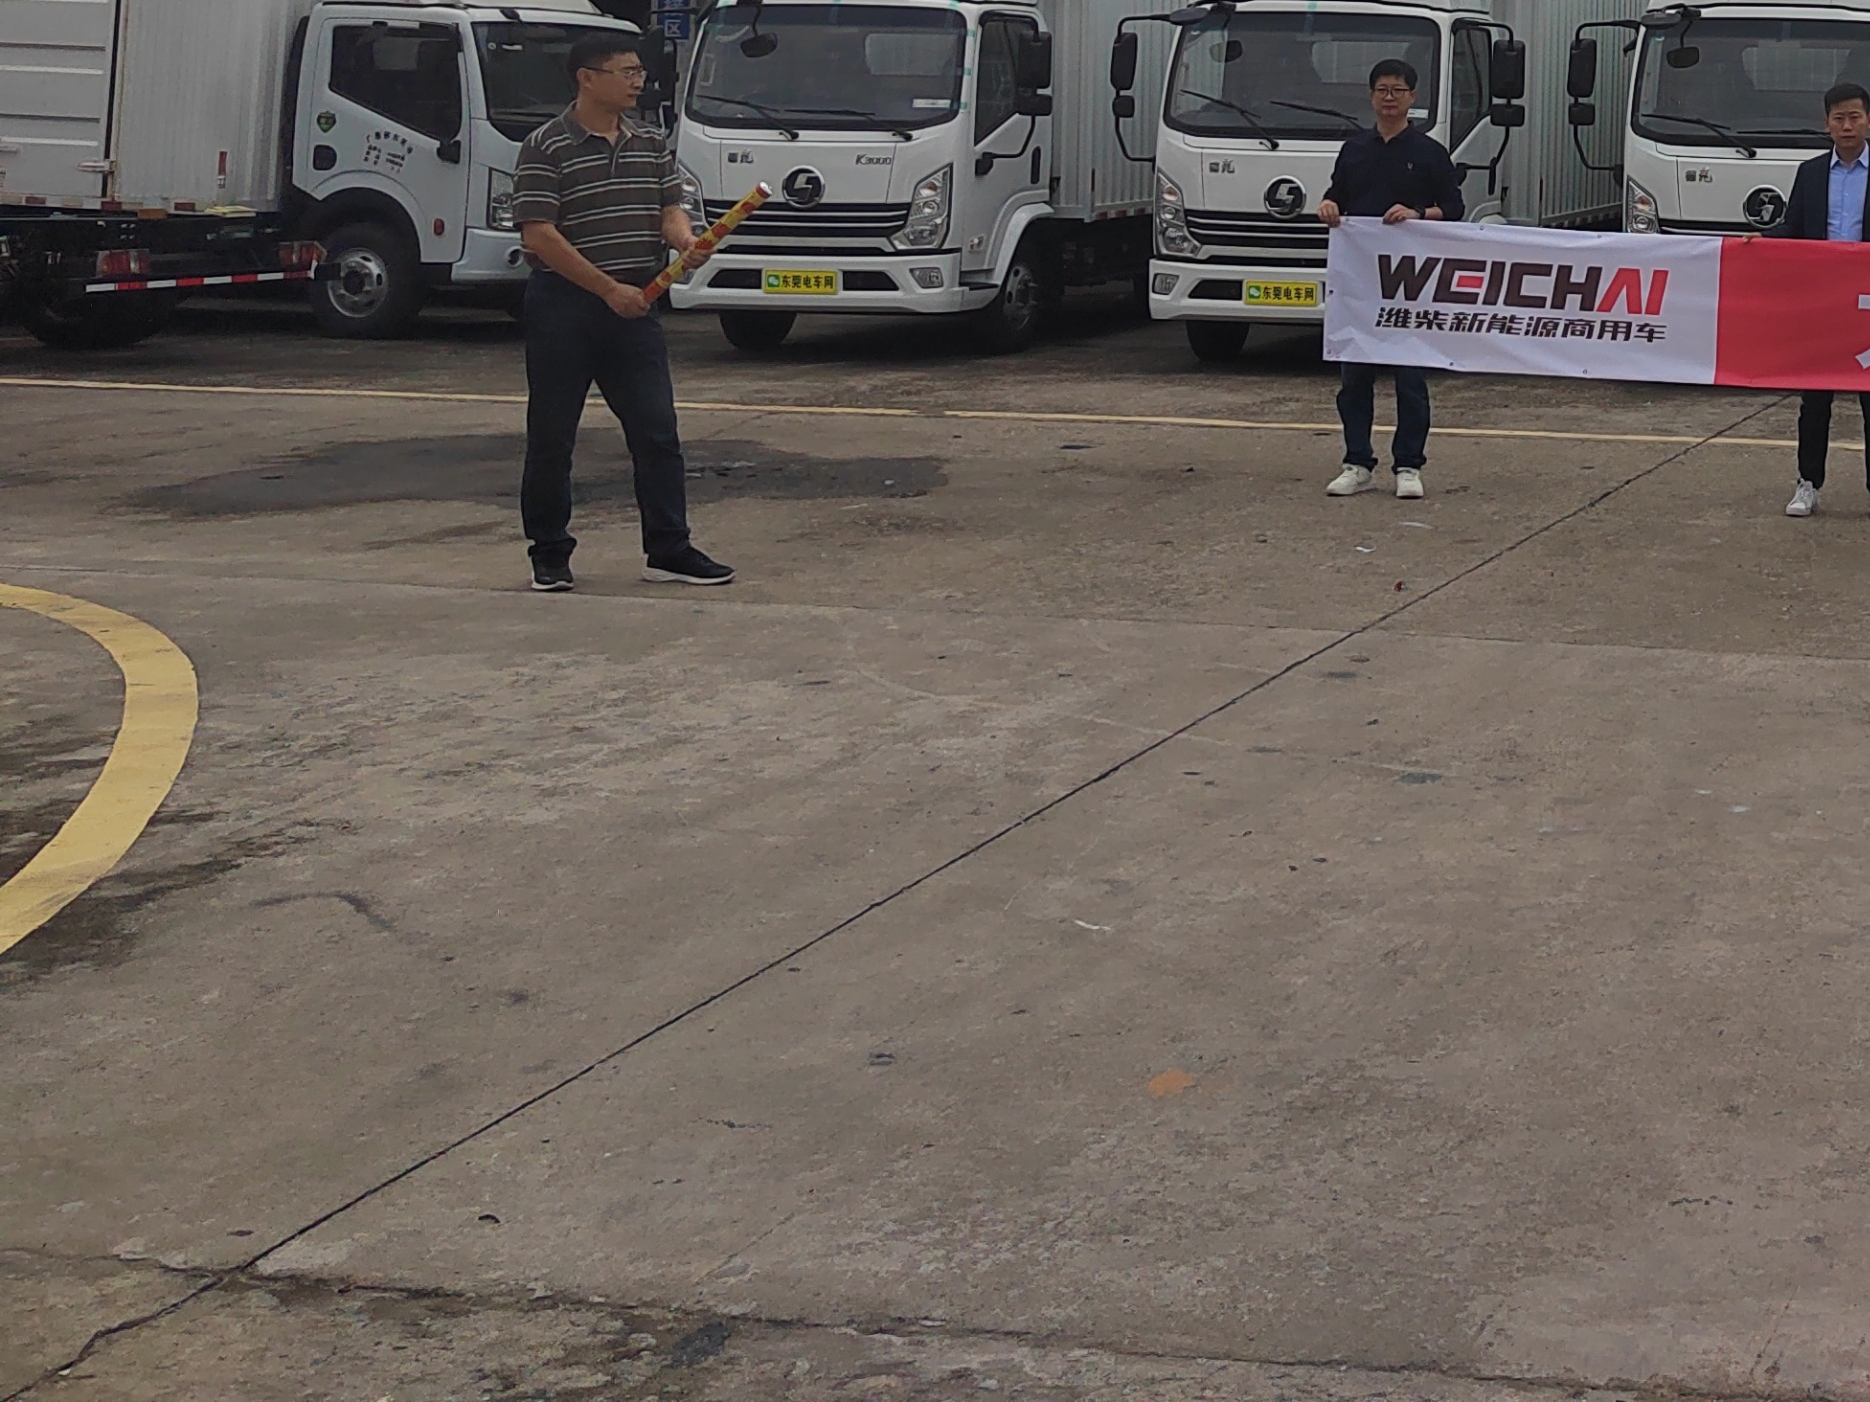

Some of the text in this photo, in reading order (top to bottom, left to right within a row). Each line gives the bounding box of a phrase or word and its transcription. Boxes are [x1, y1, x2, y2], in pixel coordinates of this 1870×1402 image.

[781, 274, 833, 289] 东莞电车网
[1378, 254, 1669, 315] WEICHAI
[1374, 307, 1667, 343] 潍柴新能源商用车
